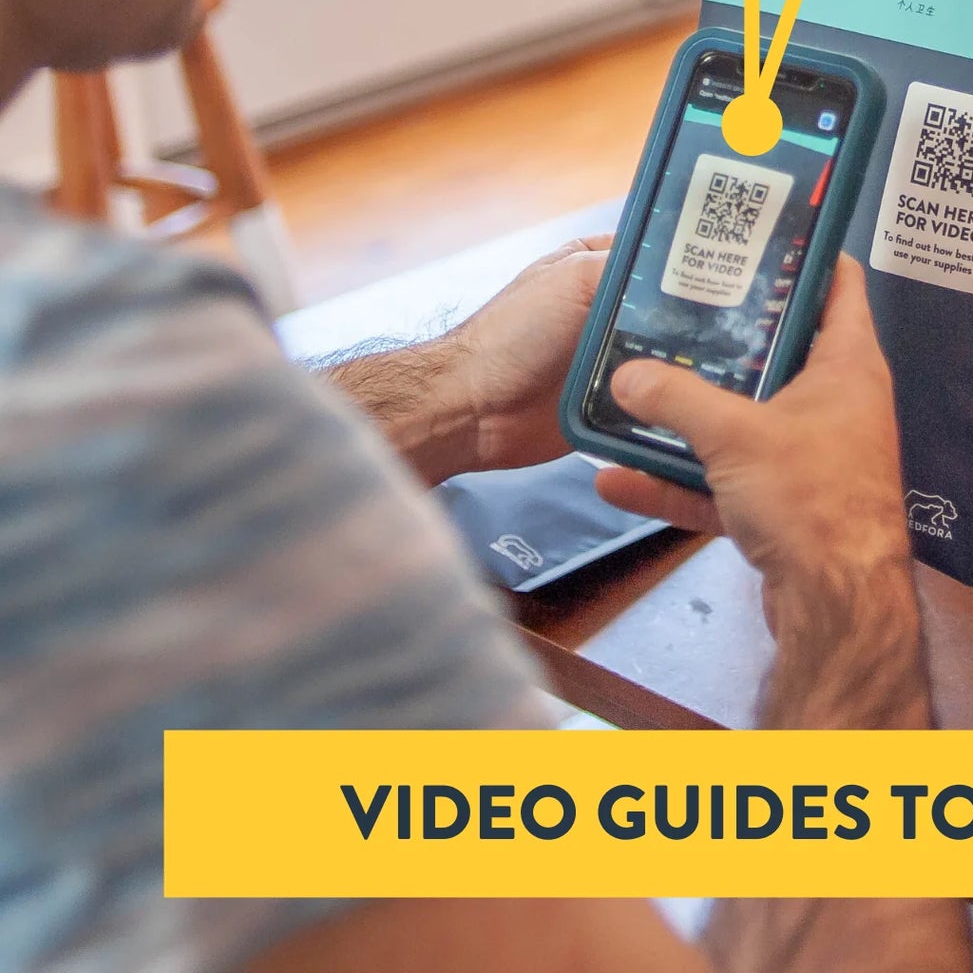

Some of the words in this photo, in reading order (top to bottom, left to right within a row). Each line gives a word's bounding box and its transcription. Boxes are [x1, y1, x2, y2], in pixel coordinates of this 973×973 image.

[897, 0, 936, 17] 个人卫生
[897, 194, 940, 217] SCAN
[895, 211, 927, 232] FOR
[683, 243, 715, 260] SCAN
[717, 252, 749, 266] HERE
[883, 230, 894, 242] To
[895, 234, 914, 248] find
[915, 242, 931, 252] out
[933, 244, 953, 257] how
[681, 255, 705, 269] FOR
[707, 261, 743, 277] VIDEO
[893, 250, 909, 260] use
[910, 254, 932, 265] your
[934, 259, 972, 275] supplies
[908, 519, 953, 540] EDFORA
